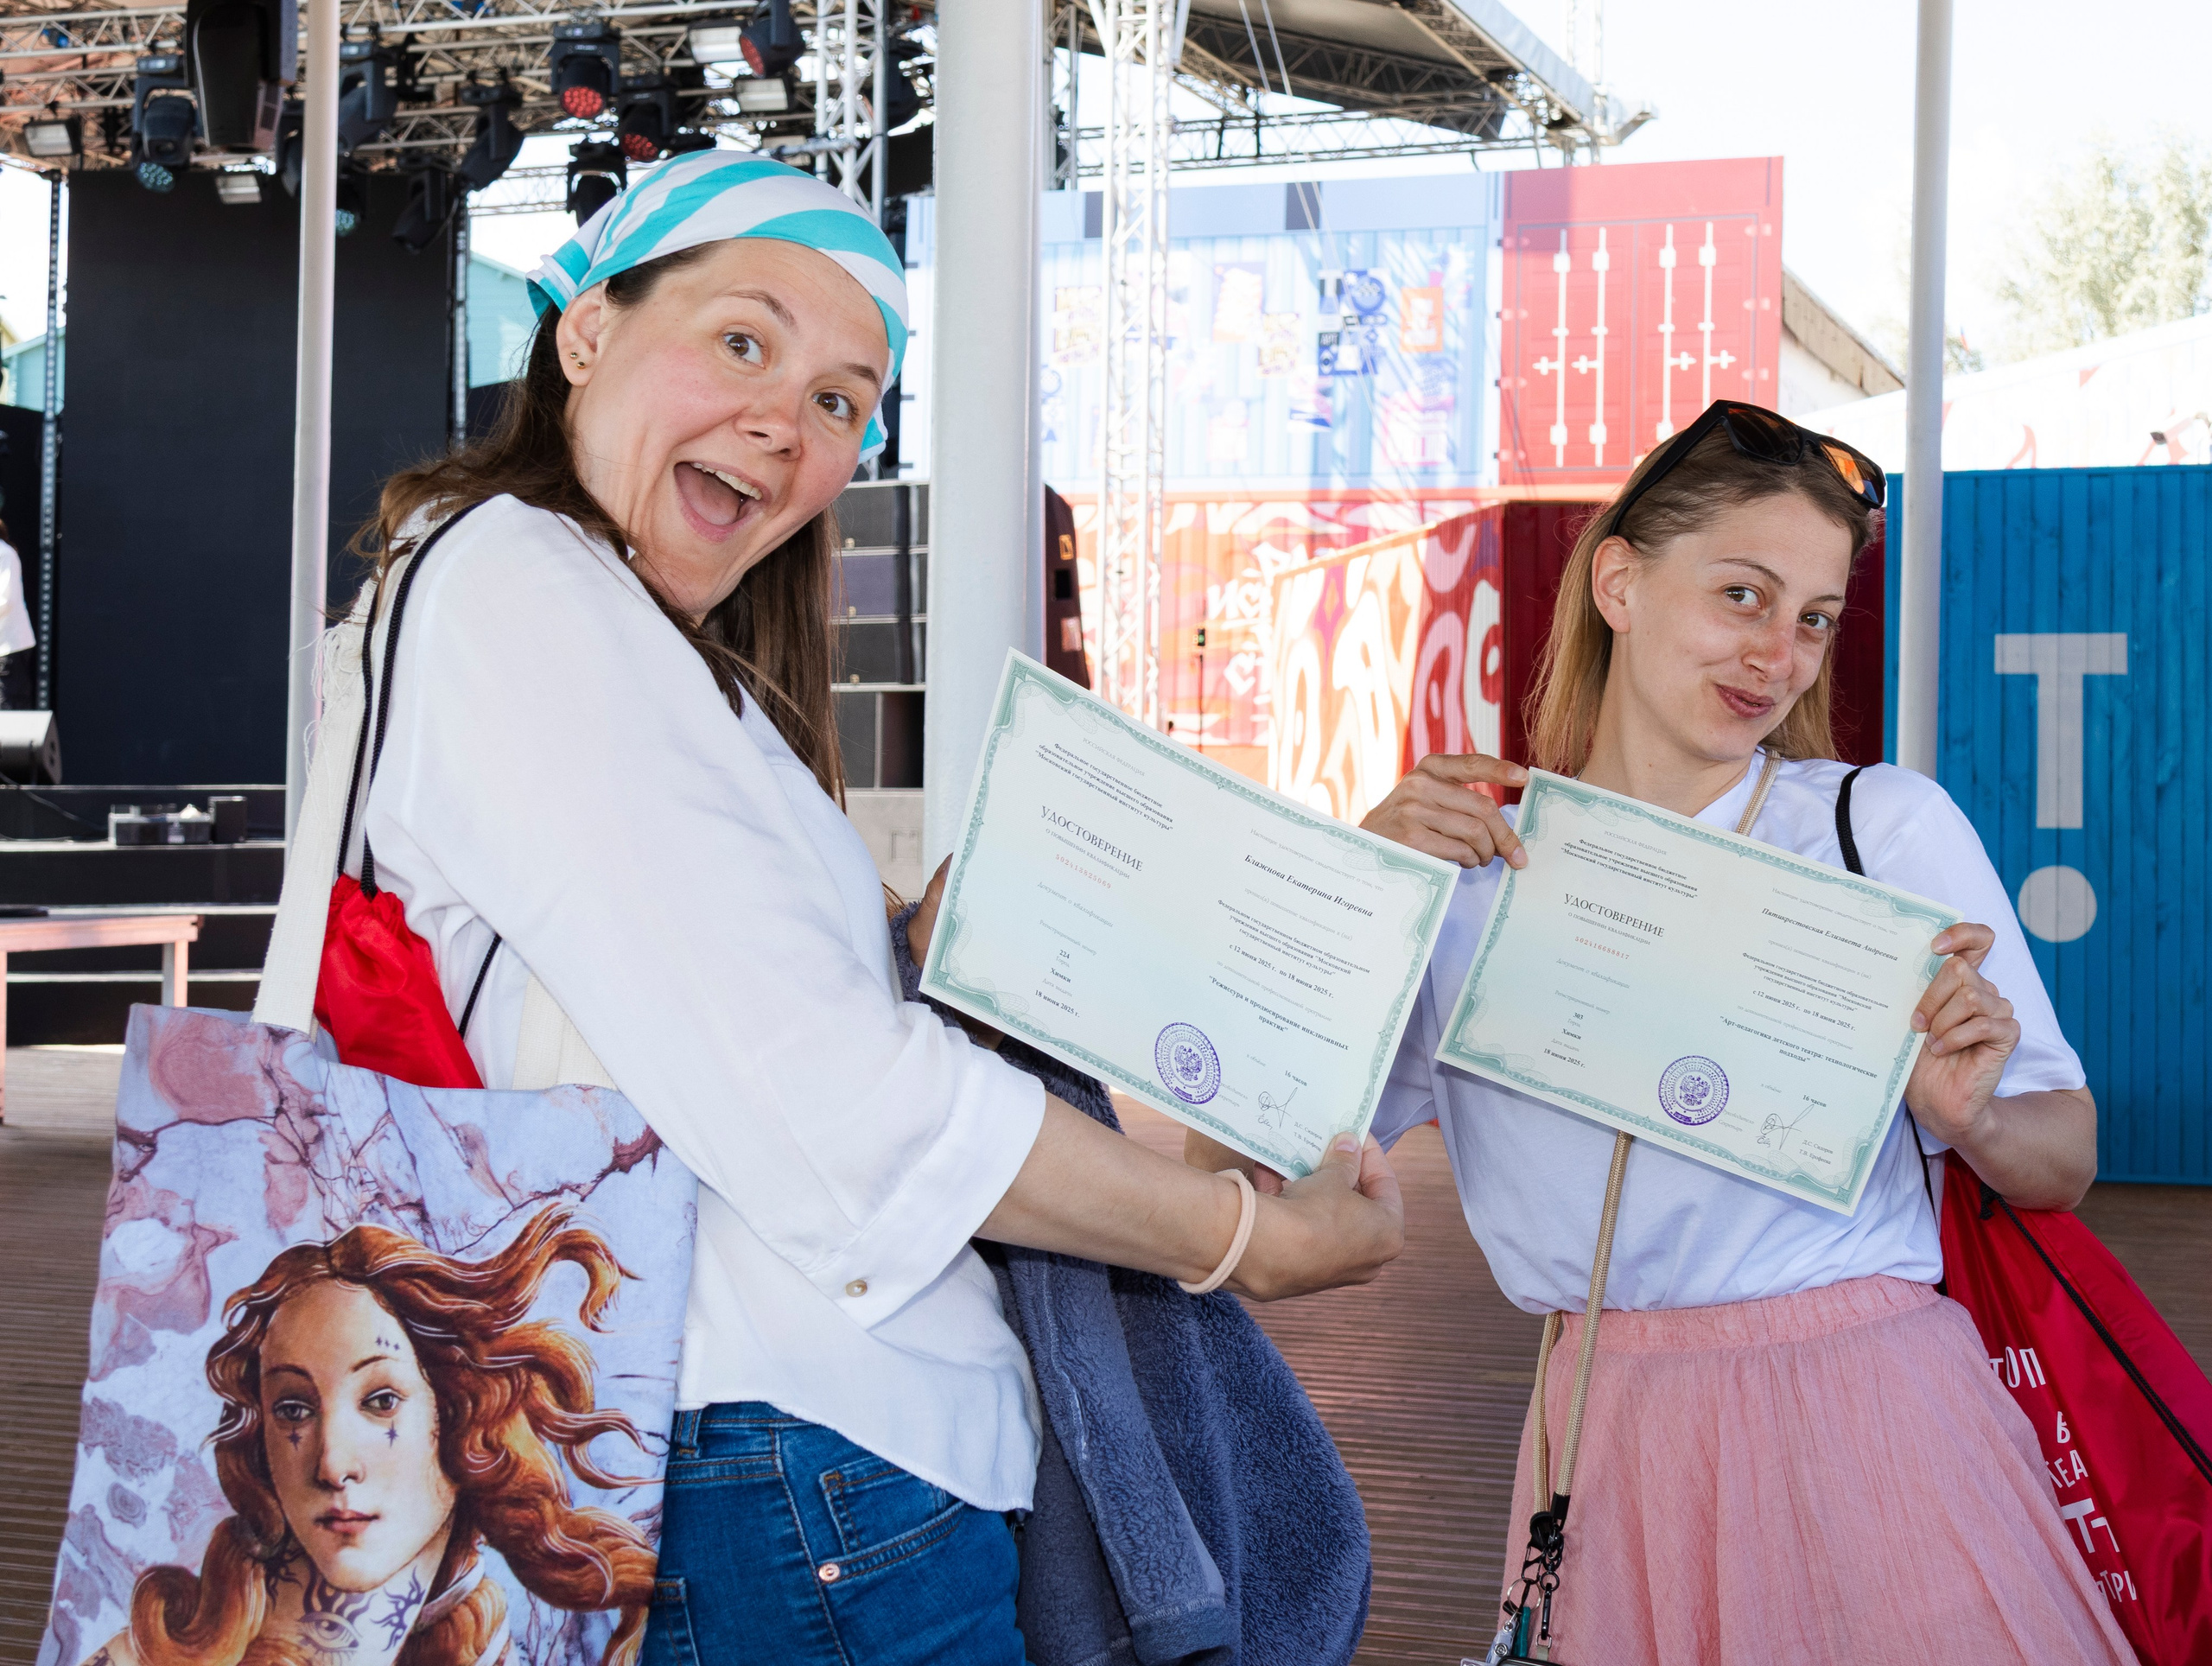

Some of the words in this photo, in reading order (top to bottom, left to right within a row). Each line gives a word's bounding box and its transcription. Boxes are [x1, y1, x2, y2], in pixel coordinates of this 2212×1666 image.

[1039, 744, 1084, 773] образовательное
[1084, 770, 1116, 791] учреждение
[1116, 788, 1140, 804] высшего
[1140, 801, 1173, 823] образования
[1054, 743, 1090, 766] Федеральное
[1090, 764, 1134, 792] государственное
[1134, 788, 1163, 808] бюджетное
[1072, 773, 1118, 801] государственный
[1119, 798, 1143, 816] институт
[1041, 806, 1143, 870] УДОСТОВЕРЕНИЕ
[1564, 842, 1608, 860] образовательное
[1609, 857, 1640, 871] учреждение
[1640, 868, 1664, 880] высшего
[1664, 877, 1698, 892] образования
[1579, 839, 1613, 855] Федеральное
[1614, 851, 1657, 869] государственное
[1658, 867, 1688, 880] бюджетное
[1597, 861, 1643, 880] государственный
[1643, 877, 1668, 888] институт
[1245, 854, 1286, 880] Блажнова
[1287, 874, 1333, 901] Екатерина
[1333, 896, 1374, 918] Игоревна
[1564, 893, 1664, 937] УДОСТОВЕРЕНИЕ
[1762, 908, 1824, 935] Пятикрестовская
[1825, 930, 1862, 948] Елизавета
[1864, 944, 1898, 961] Андреевна
[1059, 950, 1071, 959] 224
[1217, 899, 1251, 920] Федеральном
[1251, 917, 1294, 941] государственном
[1293, 938, 1324, 955] бюджетном
[1323, 951, 1370, 974] образовательном
[1230, 915, 1260, 932] учреждении
[1259, 930, 1282, 944] высшего
[1282, 941, 1314, 958] образования
[1239, 928, 1282, 952] государственный
[1281, 950, 1306, 963] институт
[1051, 968, 1071, 982] Химки
[1242, 950, 1258, 962] июня
[1258, 957, 1272, 969] 2025
[1295, 977, 1313, 989] июня
[1313, 984, 1329, 995] 2025
[1742, 952, 1776, 968] Федеральном
[1776, 964, 1817, 982] государственном
[1818, 979, 1847, 993] бюджетном
[1847, 990, 1889, 1008] образовательном
[1754, 965, 1783, 978] учреждении
[1784, 976, 1806, 986] высшего
[1807, 983, 1838, 997] образования
[1764, 976, 1806, 994] государственный
[1806, 991, 1829, 1002] институт
[1043, 995, 1060, 1007] июня
[1060, 1002, 1075, 1014] 2025
[1209, 976, 1244, 1000] "Режиссура
[1301, 1026, 1349, 1050] инклюзивных
[1258, 1015, 1288, 1033] практик"
[1765, 995, 1782, 1003] июня
[1782, 1000, 1796, 1008] 2025
[1820, 1014, 1836, 1024] июня
[1837, 1020, 1851, 1028] 2025
[1562, 1028, 1582, 1040] Химки
[1719, 1016, 1772, 1040] "Арт-педагогика
[1772, 1036, 1801, 1050] детского
[1801, 1046, 1824, 1059] театра:
[1826, 1056, 1878, 1078] технологические
[1551, 1052, 1567, 1060] июня
[1567, 1057, 1580, 1065] 2025
[1779, 1048, 1810, 1063] подходы"
[1292, 1074, 1308, 1086] часов
[1810, 1098, 1827, 1107] часов
